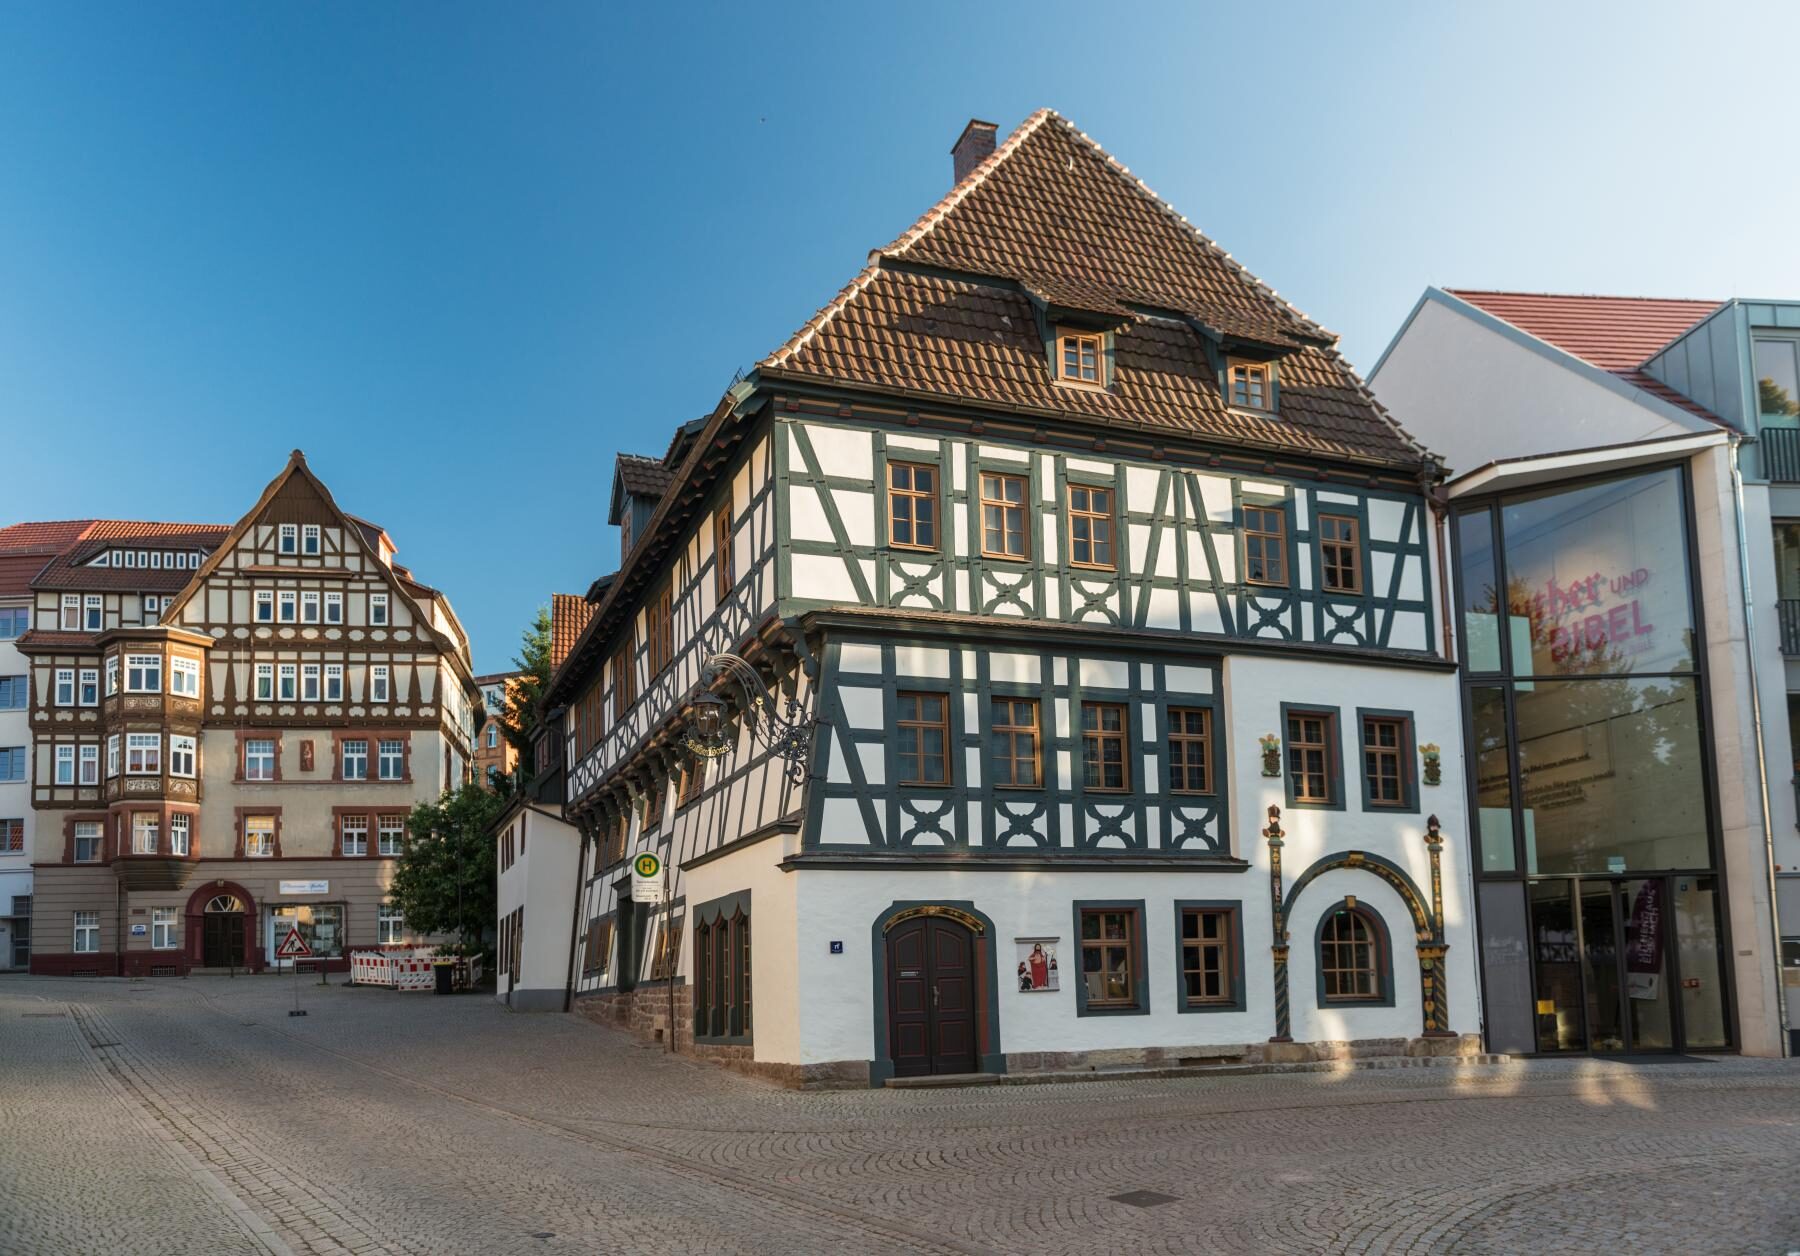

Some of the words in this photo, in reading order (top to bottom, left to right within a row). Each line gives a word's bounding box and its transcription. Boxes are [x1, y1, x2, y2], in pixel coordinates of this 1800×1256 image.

[1609, 568, 1650, 595] UND
[1549, 599, 1653, 663] BIBEL
[642, 860, 652, 871] H
